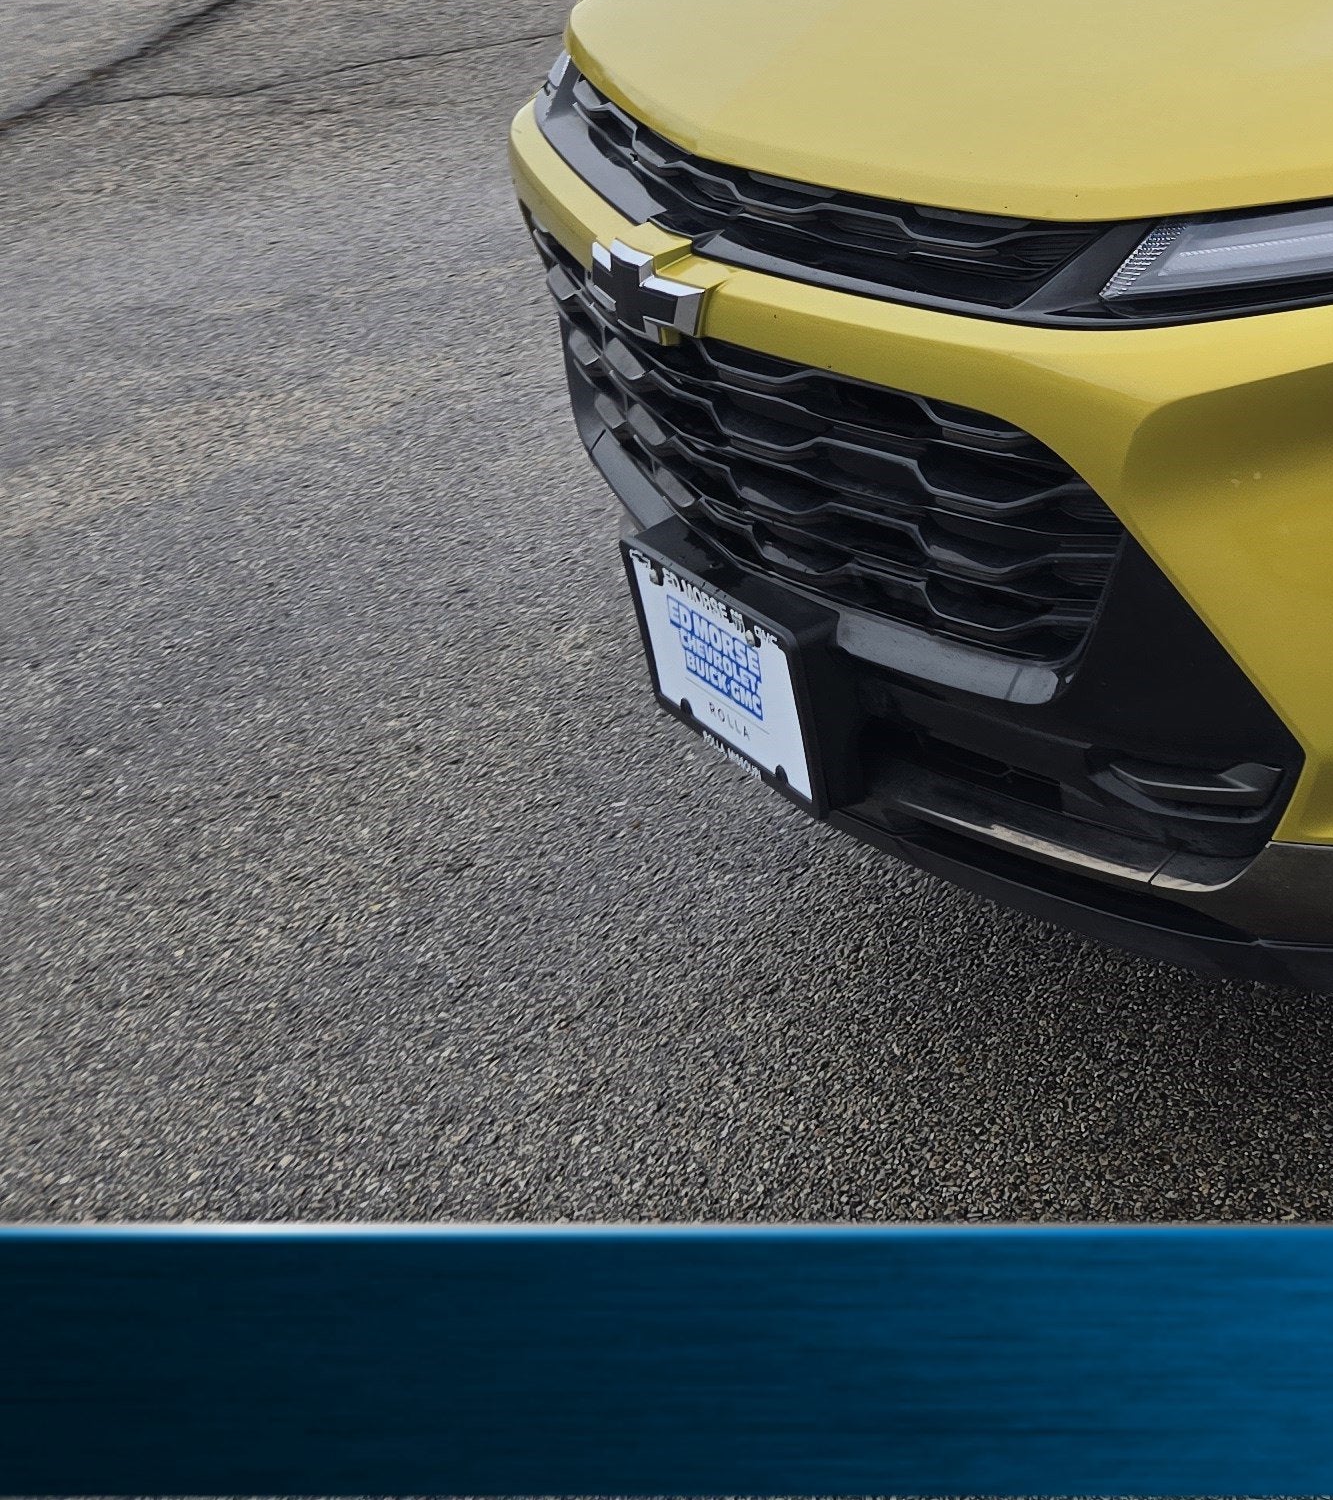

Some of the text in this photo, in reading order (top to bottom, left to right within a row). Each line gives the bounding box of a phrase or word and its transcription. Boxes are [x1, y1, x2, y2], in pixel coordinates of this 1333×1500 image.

[668, 596, 761, 678] ED MORSE
[708, 701, 750, 741] ROLLA
